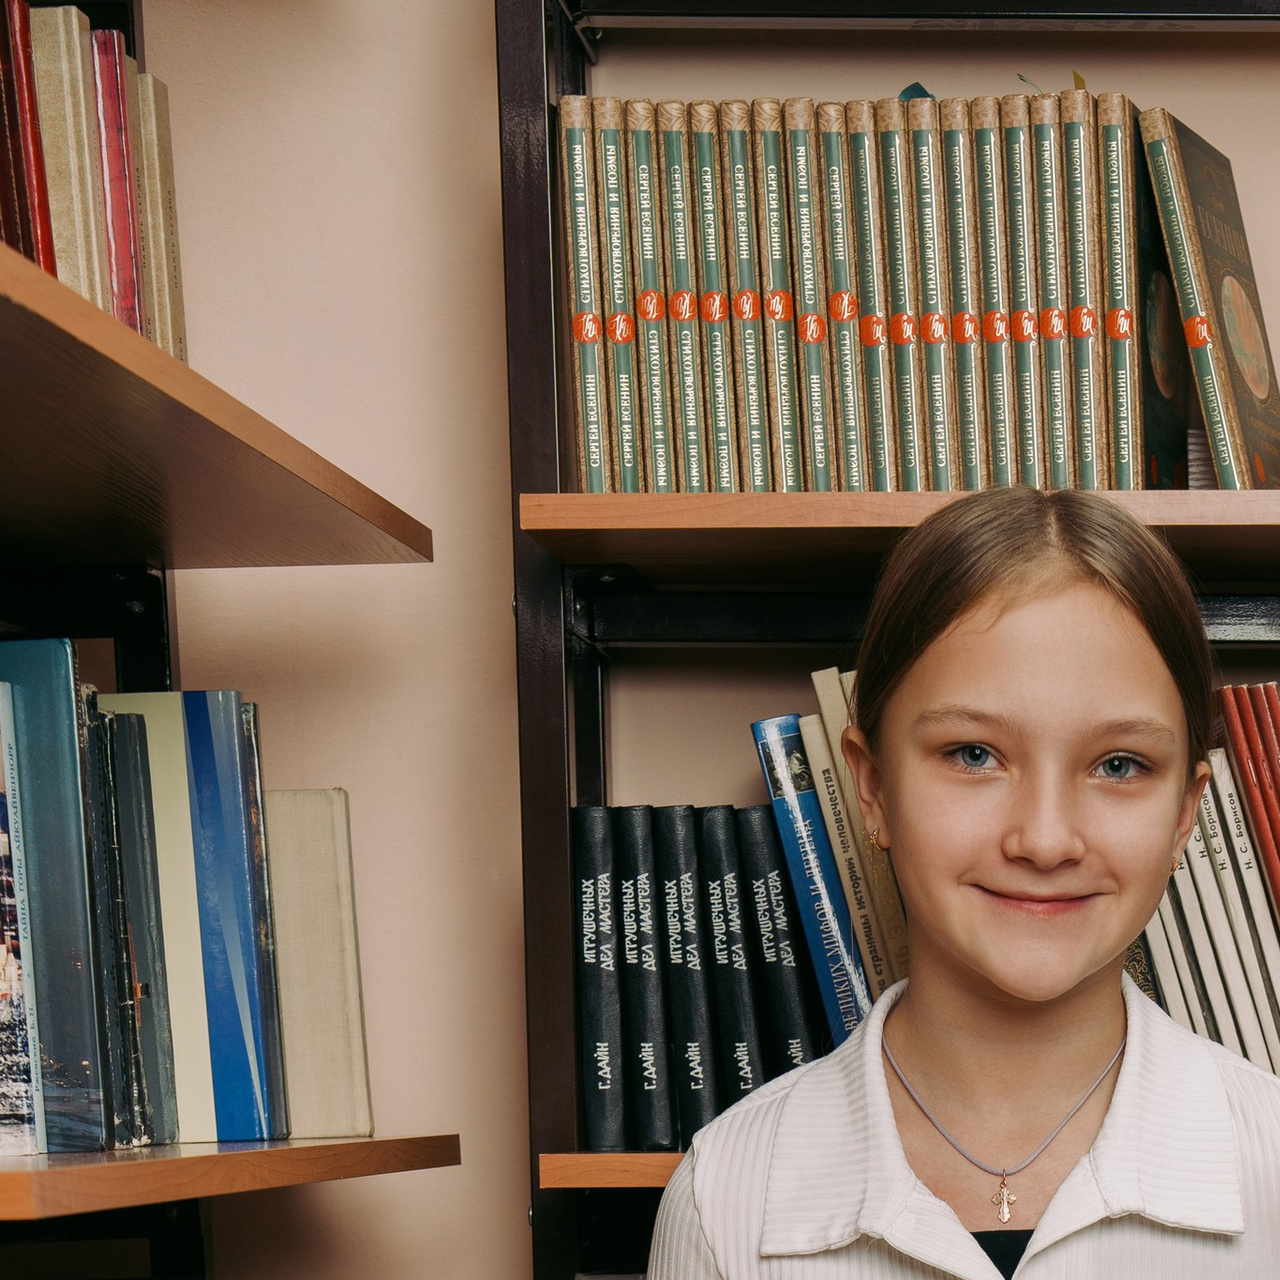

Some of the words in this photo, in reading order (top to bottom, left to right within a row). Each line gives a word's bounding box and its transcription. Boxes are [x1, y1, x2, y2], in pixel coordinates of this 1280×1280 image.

[573, 145, 585, 188] ПОЭМЫ
[607, 146, 618, 188] ПОЭМЫ
[639, 165, 652, 209] СЕРГЕЙ
[576, 193, 585, 201] И
[609, 194, 619, 202] И
[576, 207, 591, 304] СТИХОТВОРЕНИЯ
[610, 207, 625, 304] СТИХОТВОРЕНИЯ
[642, 212, 654, 260] ЕСЕНИН
[586, 375, 598, 422] ЕСЕНИН
[620, 375, 632, 422] ЕСЕНИН
[649, 330, 664, 426] СТИХОТВОРЕНИЯ
[589, 425, 601, 468] СЕРГЕЙ
[622, 425, 634, 467] СЕРГЕЙ
[655, 432, 664, 440] И
[656, 446, 668, 487] ПОЭМЫ
[1228, 793, 1245, 839] Борисов
[1240, 842, 1248, 854] С.
[1245, 858, 1254, 870] Н.
[14, 858, 25, 892] ГОРЫ
[17, 899, 29, 942] ТАЙНА
[582, 879, 597, 964] ИГРУШЕЧНЫХ
[598, 873, 612, 934] МАСТЕРА
[622, 880, 639, 964] ИГРУШЕЧНЫХ
[637, 873, 653, 934] МАСТЕРА
[665, 880, 684, 964] ИГРУШЕЧНЫХ
[681, 873, 697, 934] МАСТЕРА
[600, 945, 615, 971] ДЕЛ
[642, 945, 657, 971] ДЕЛ
[687, 944, 702, 971] ДЕЛ
[831, 960, 858, 1033] ВЕЛИКИХ
